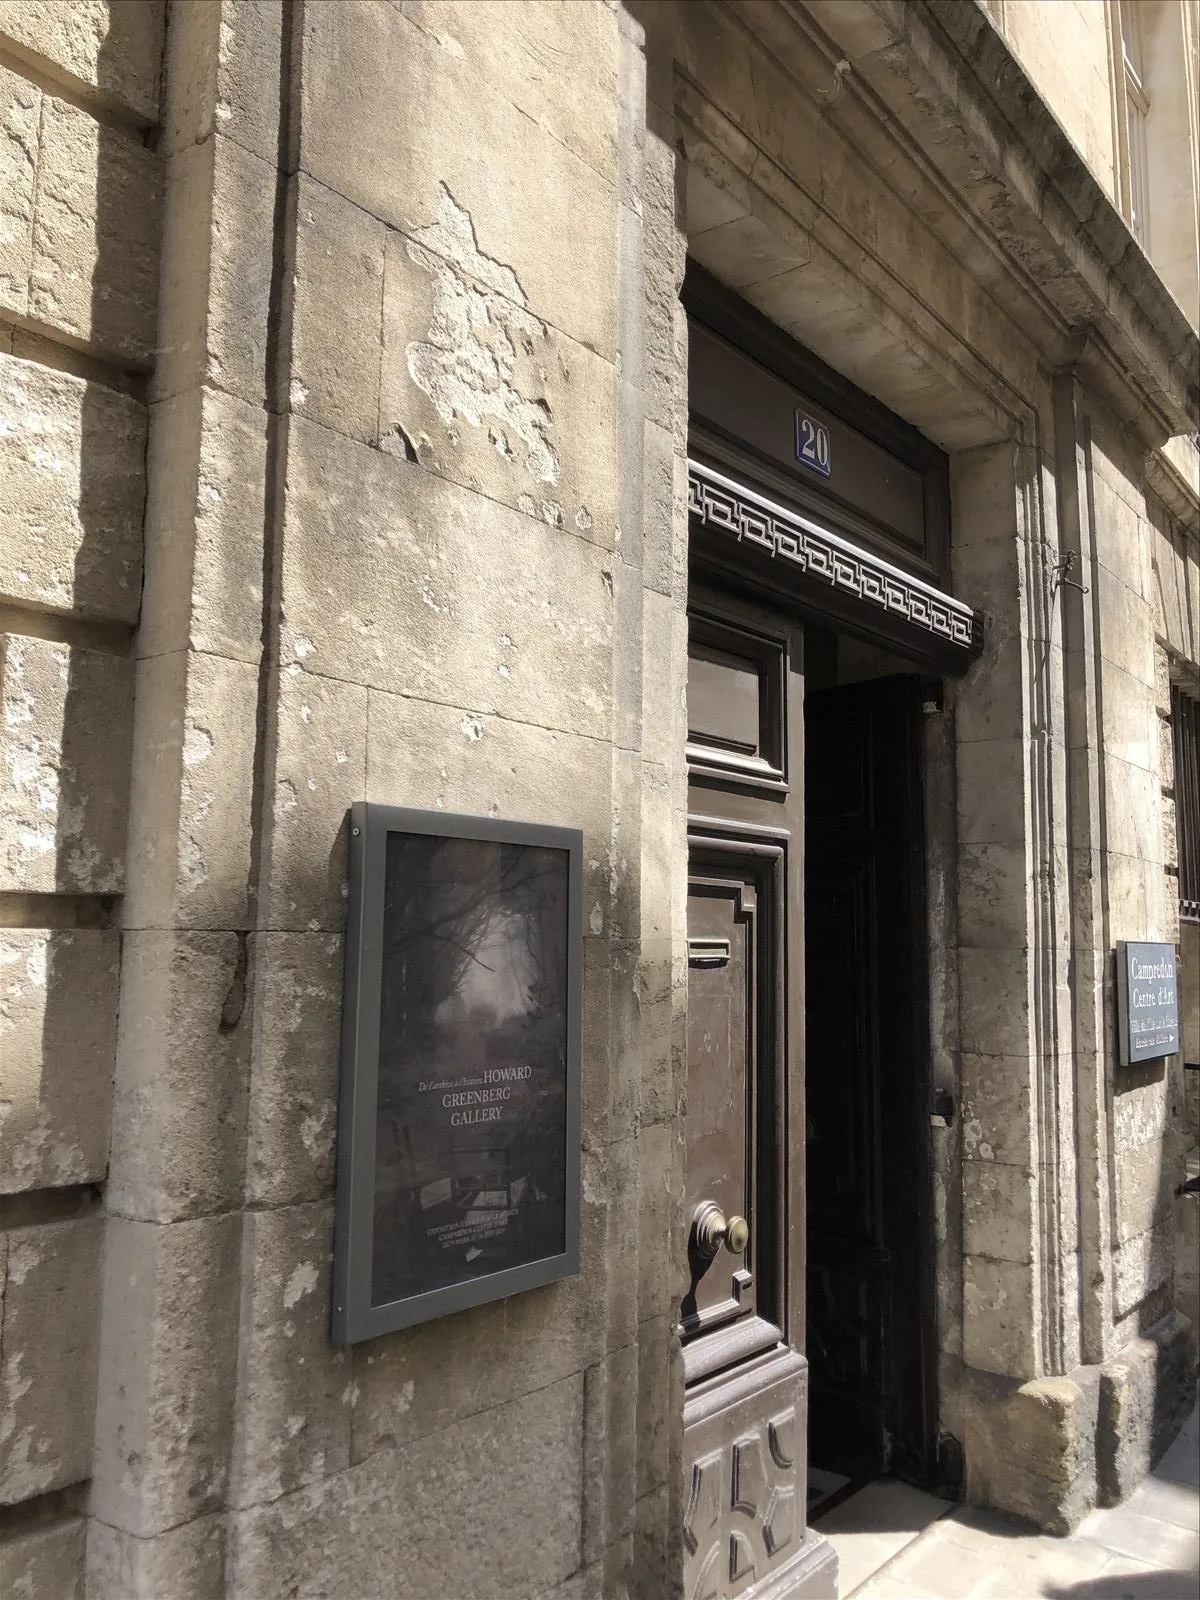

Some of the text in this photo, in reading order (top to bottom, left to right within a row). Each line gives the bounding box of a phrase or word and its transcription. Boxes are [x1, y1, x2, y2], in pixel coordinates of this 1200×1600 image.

[802, 420, 828, 466] 20
[1131, 957, 1174, 984] Campredon
[1133, 986, 1175, 1008] Centre d'Art
[484, 1065, 532, 1083] HOWARD
[442, 1086, 511, 1108] GREENBERG
[451, 1106, 503, 1126] GALLERY
